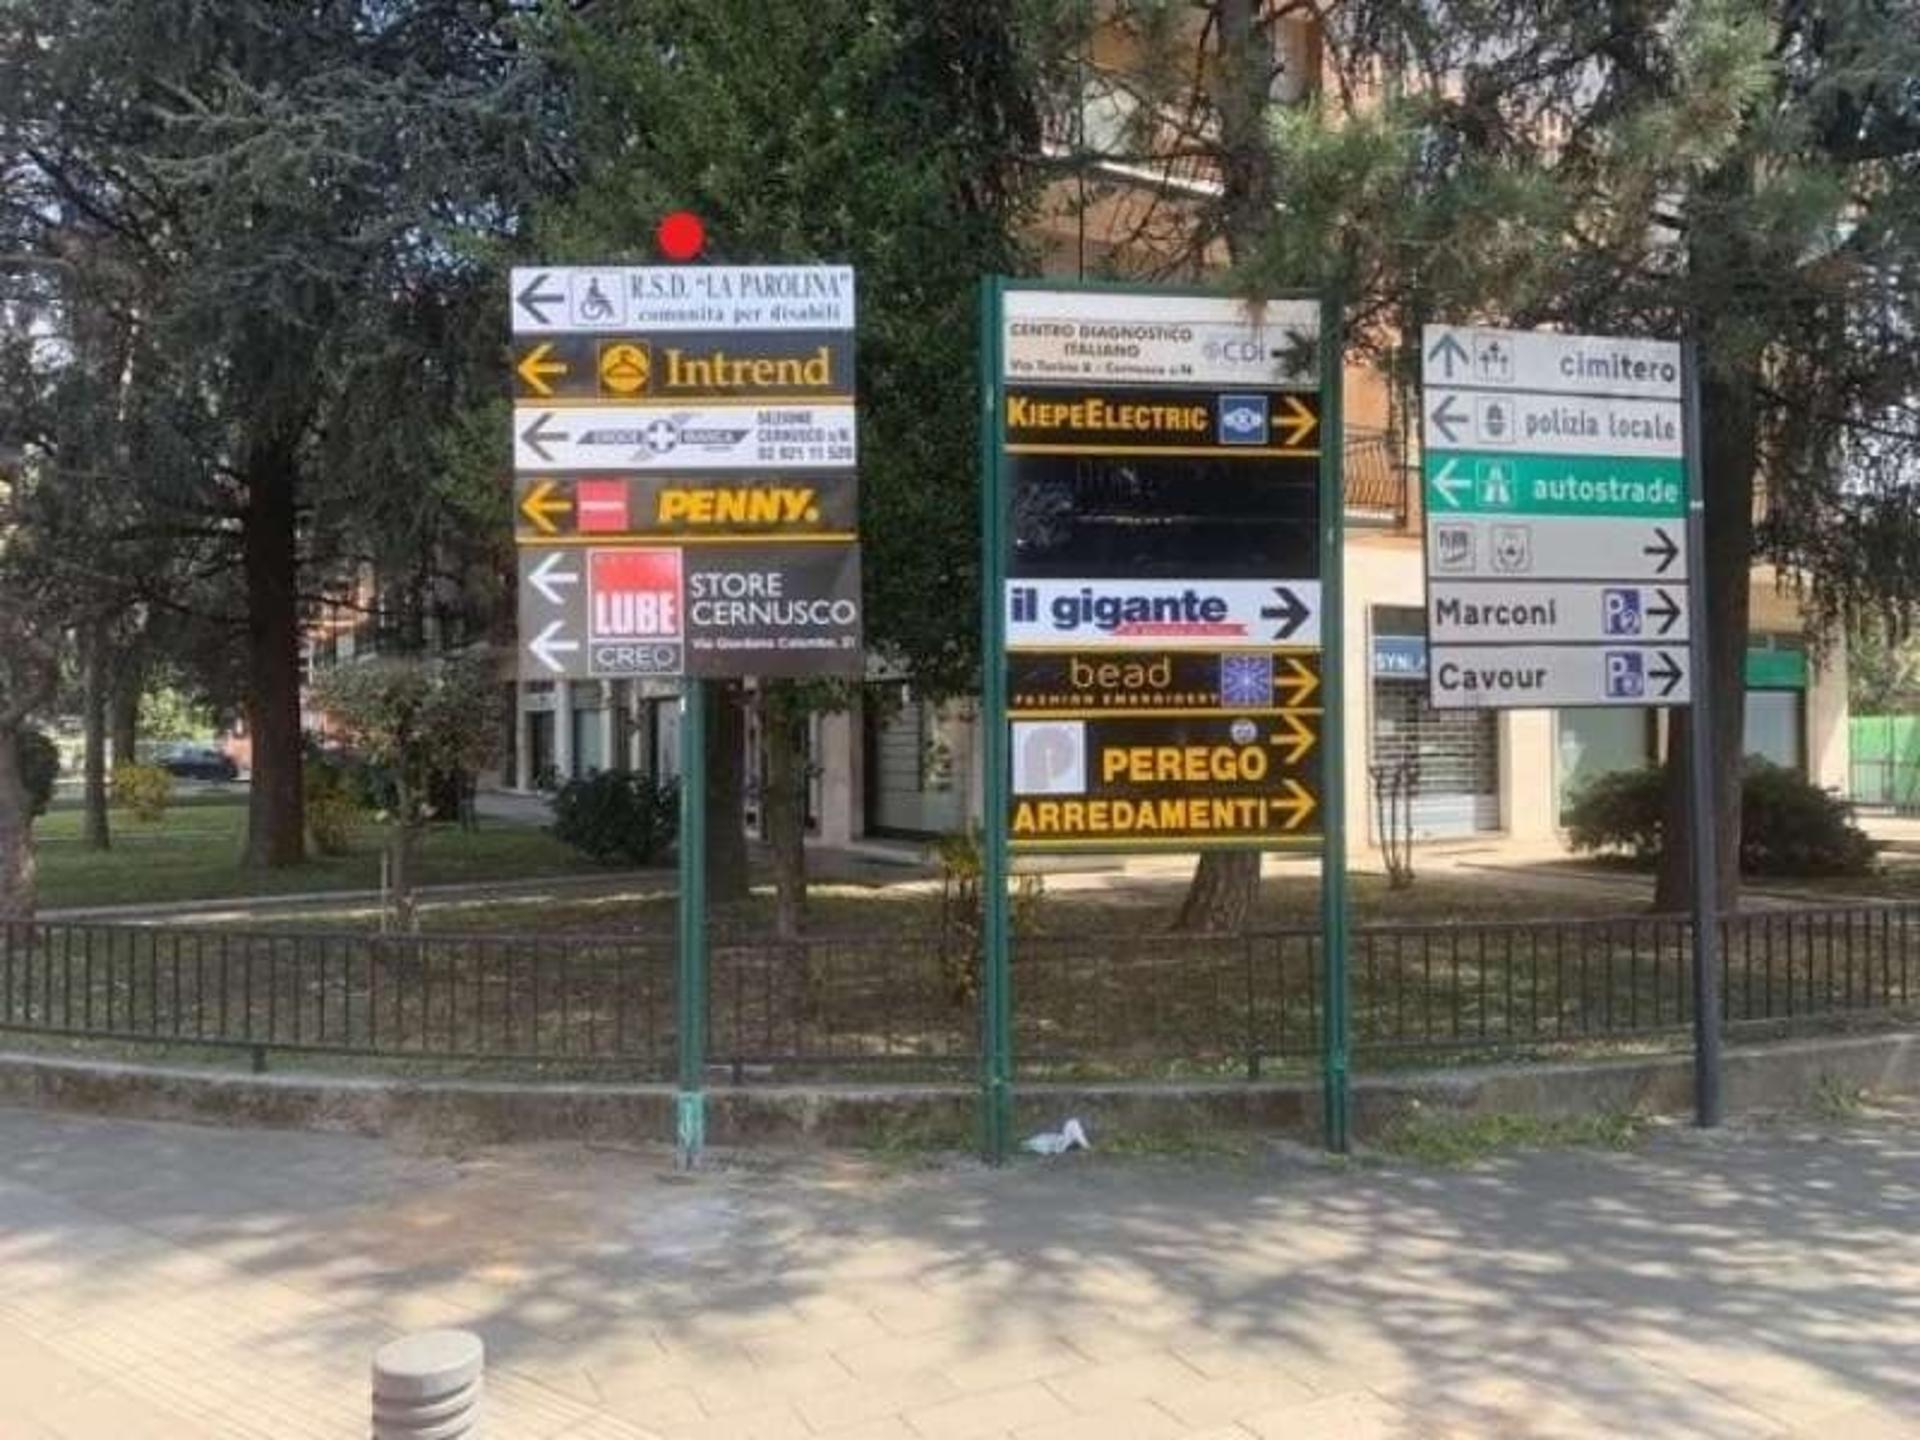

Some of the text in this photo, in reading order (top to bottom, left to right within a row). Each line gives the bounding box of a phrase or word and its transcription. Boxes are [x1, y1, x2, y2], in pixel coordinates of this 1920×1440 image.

[631, 274, 689, 299] R.S.D.
[734, 307, 760, 324] per
[769, 303, 840, 321] disabili
[1010, 323, 1193, 342] CENTRO DIAGNOSTICO
[1064, 343, 1142, 358] ITALIANO
[665, 348, 831, 388] Intrend
[1560, 352, 1676, 382] cimitero
[1526, 409, 1676, 441] polizia locale
[1533, 473, 1679, 505] autostrade
[689, 572, 784, 598] STORE
[595, 590, 676, 635] LUBE
[692, 599, 857, 626] CERNUSCO
[1010, 588, 1229, 631] il gigante
[1437, 599, 1557, 627] Marconi
[596, 645, 675, 666] CREO
[1071, 655, 1172, 688] bead
[1438, 663, 1548, 690] Cavour
[1103, 747, 1268, 782] PEREGO
[1013, 800, 1268, 832] ARREDAMENTI
